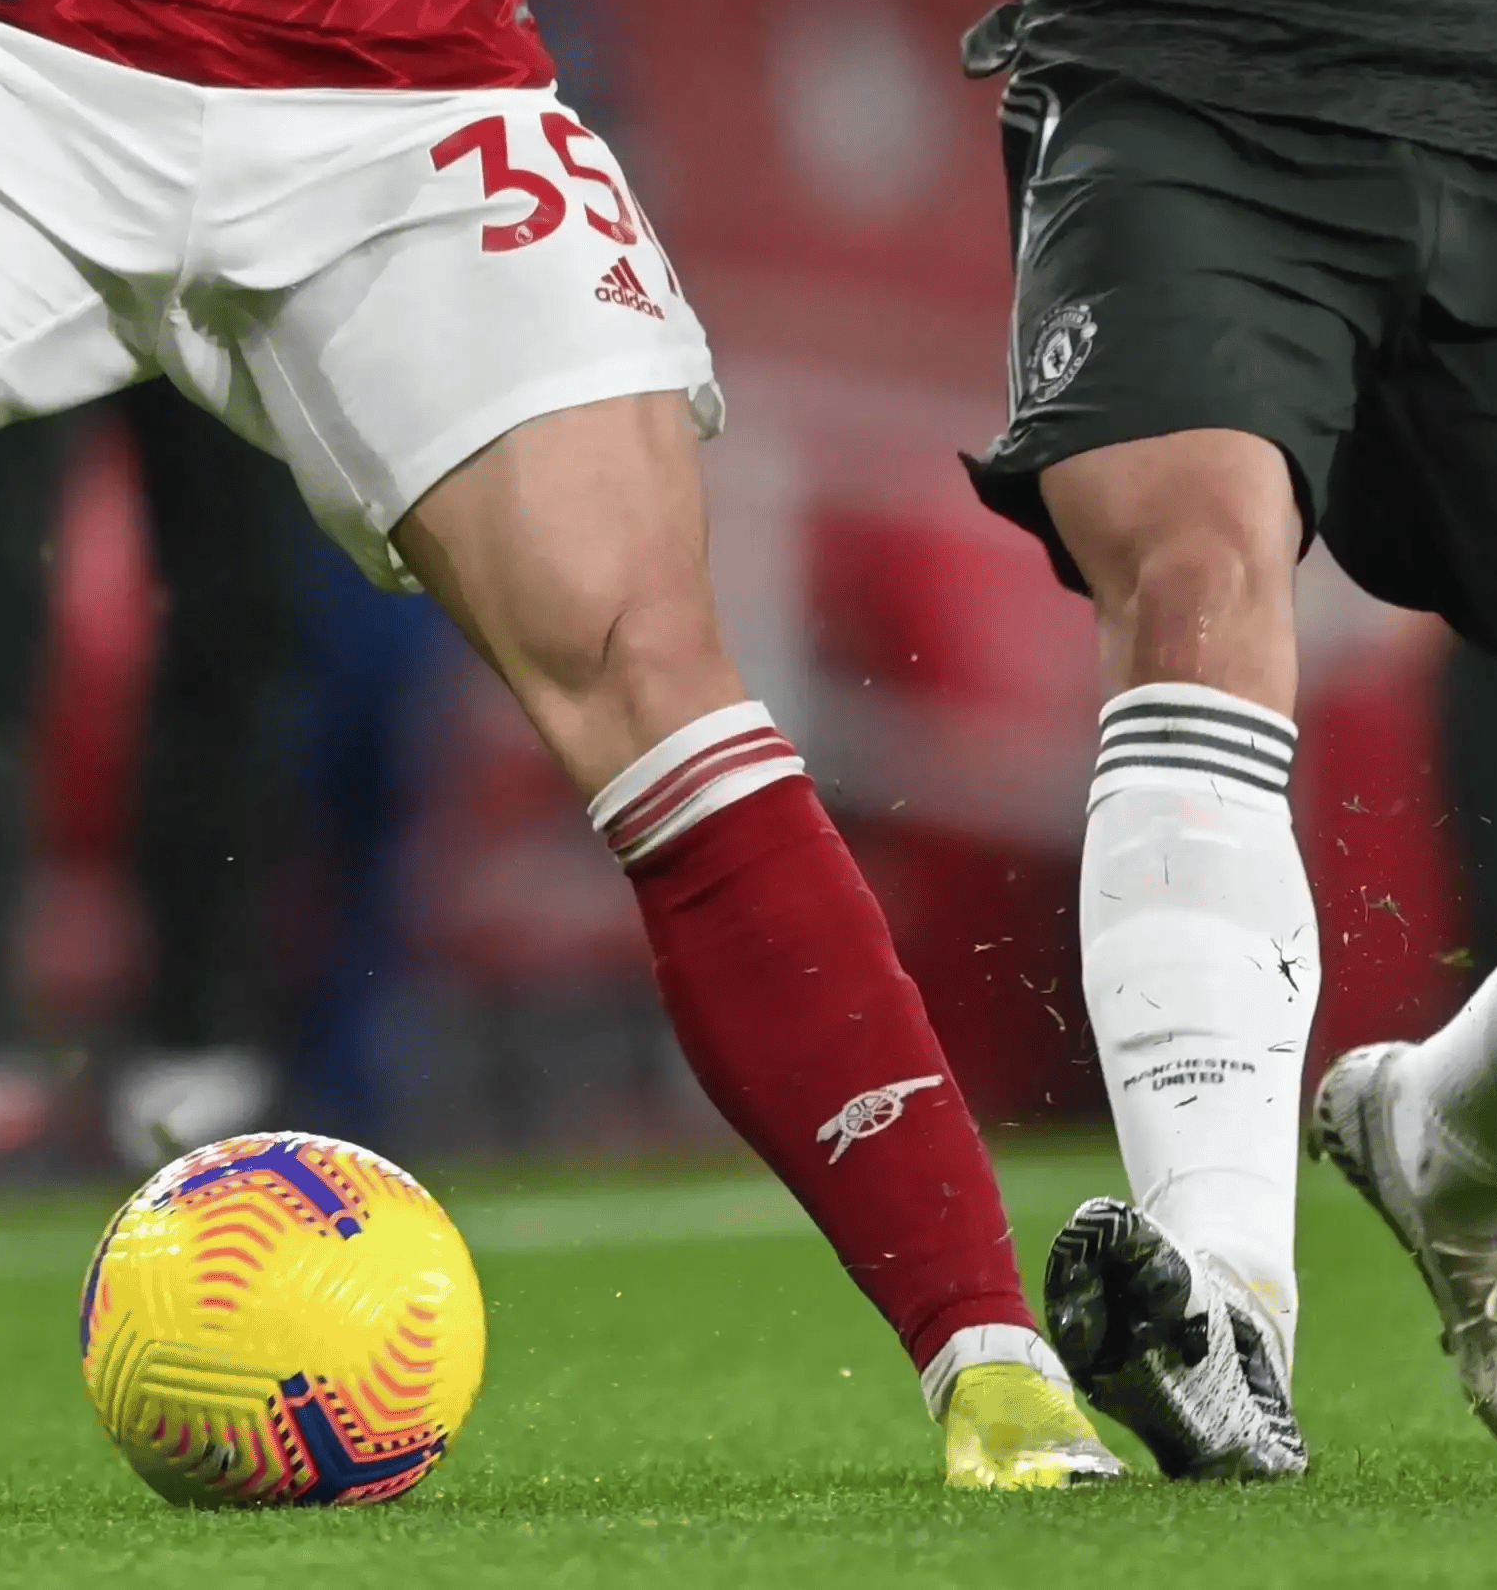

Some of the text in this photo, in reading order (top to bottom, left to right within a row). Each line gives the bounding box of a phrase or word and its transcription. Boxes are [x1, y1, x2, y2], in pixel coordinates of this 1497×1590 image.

[429, 111, 638, 253] 35
[595, 284, 666, 322] adidas
[1152, 1071, 1225, 1092] UNITED
